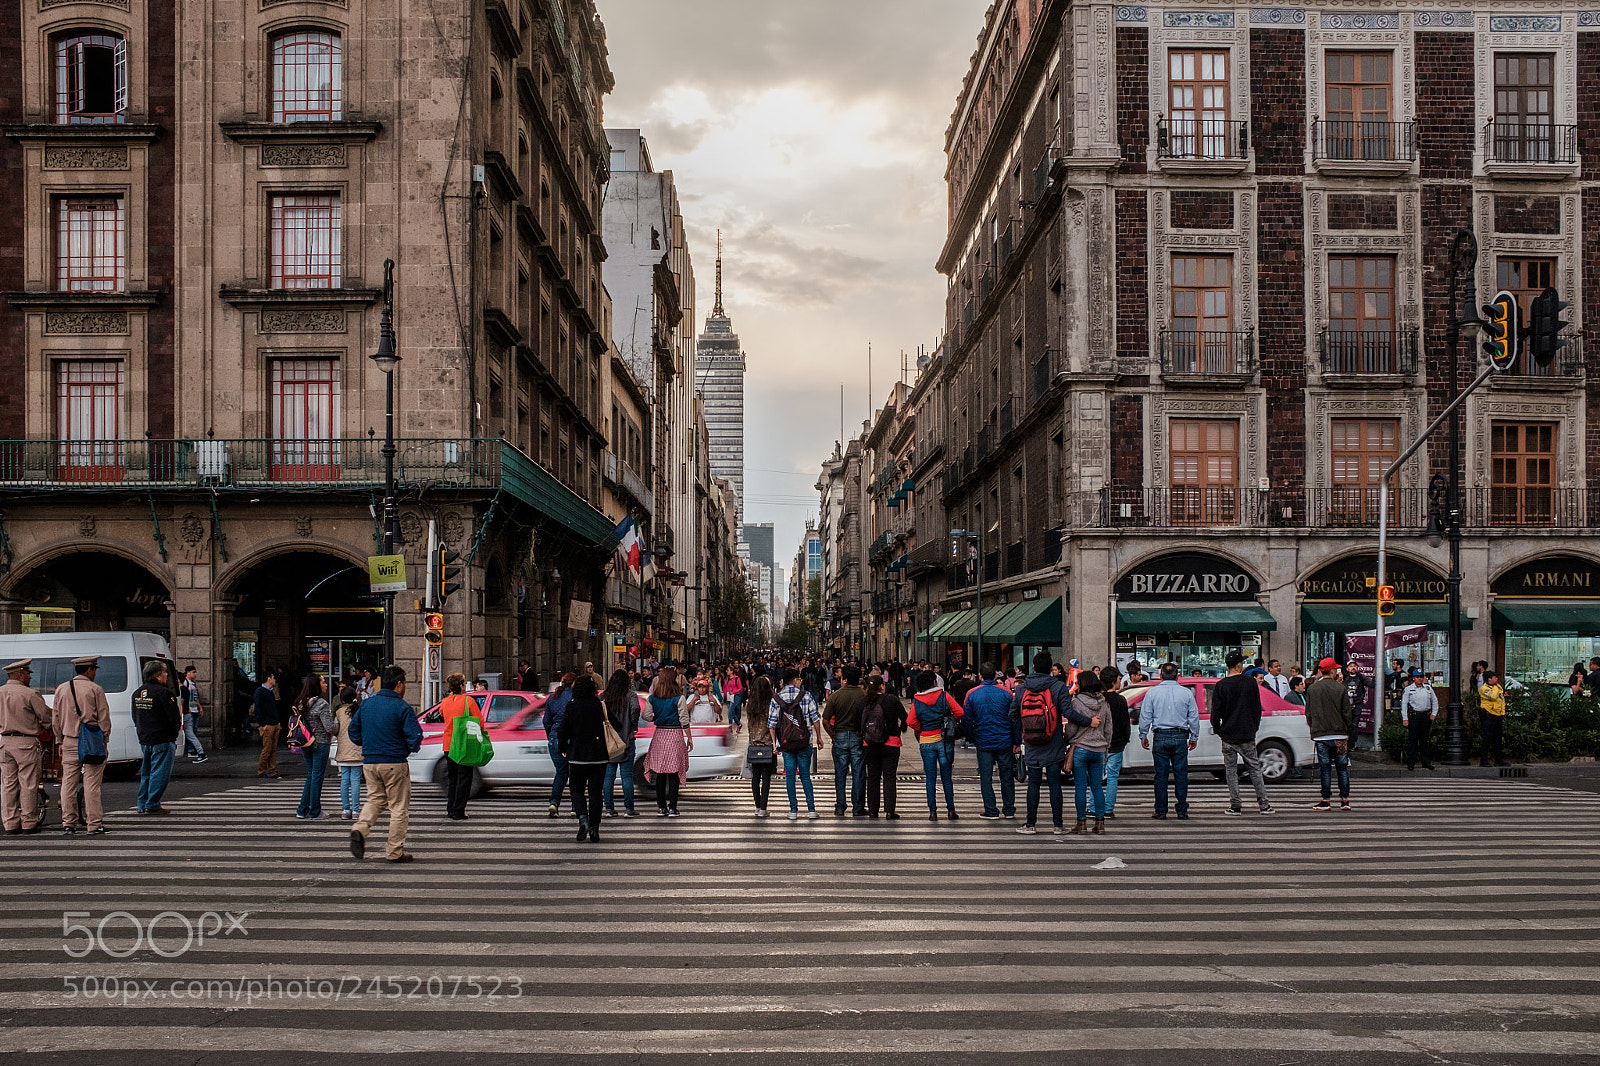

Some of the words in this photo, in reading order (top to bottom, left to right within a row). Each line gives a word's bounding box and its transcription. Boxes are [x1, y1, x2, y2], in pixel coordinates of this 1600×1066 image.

[1130, 574, 1250, 593] BIZZARRO
[1303, 580, 1363, 593] REGALOS
[1394, 580, 1446, 593] MEXICO
[1522, 572, 1591, 587] ARMANI
